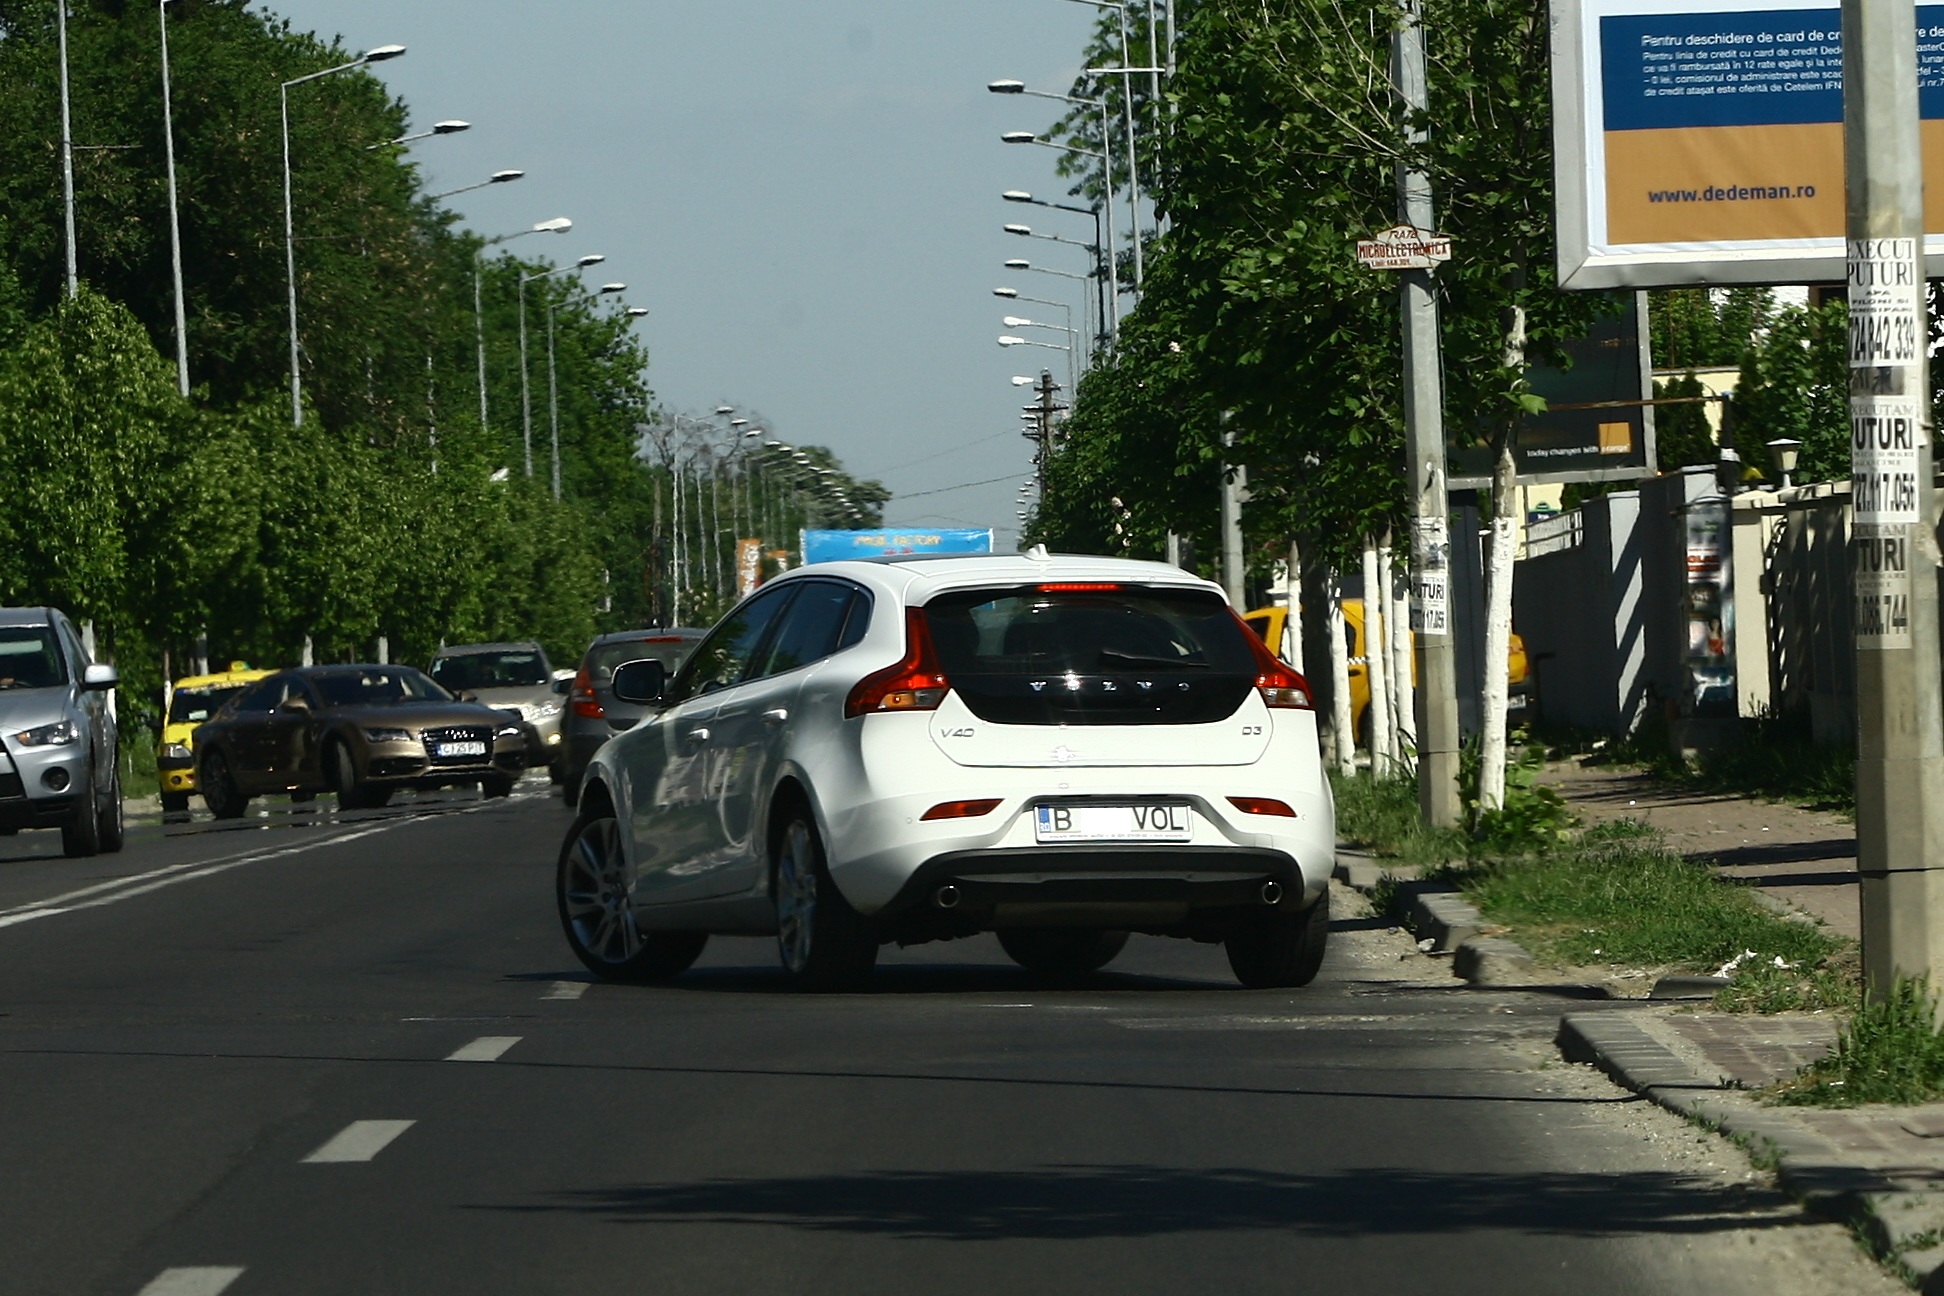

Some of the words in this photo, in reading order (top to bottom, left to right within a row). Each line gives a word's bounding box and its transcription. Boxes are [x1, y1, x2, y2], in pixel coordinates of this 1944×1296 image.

[1641, 34, 1682, 46] Pentru
[1685, 33, 1754, 45] deschidere
[1757, 32, 1773, 43] de
[1776, 30, 1805, 42] card
[1808, 29, 1824, 41] de
[1696, 51, 1708, 59] de
[1710, 50, 1737, 58] credit
[1753, 48, 1774, 57] card
[1776, 48, 1789, 56] de
[1791, 47, 1818, 55] credit
[1744, 61, 1755, 69] 12
[1757, 61, 1776, 69] rate
[1778, 60, 1804, 70] egale
[1816, 59, 1825, 67] la
[1726, 73, 1739, 82] de
[1741, 71, 1798, 81] administrare
[1800, 71, 1820, 80] este
[1716, 85, 1736, 94] este
[1770, 83, 1783, 92] de
[1825, 81, 1842, 90] IFN
[1648, 184, 1816, 203] www.dedeman.ro
[1359, 241, 1448, 258] MICROELECTRONICA
[1847, 261, 1913, 286] PUTURI
[940, 727, 975, 738] V40
[1241, 726, 1262, 736] D3
[1054, 807, 1072, 831] B
[1131, 806, 1184, 831] VOL
